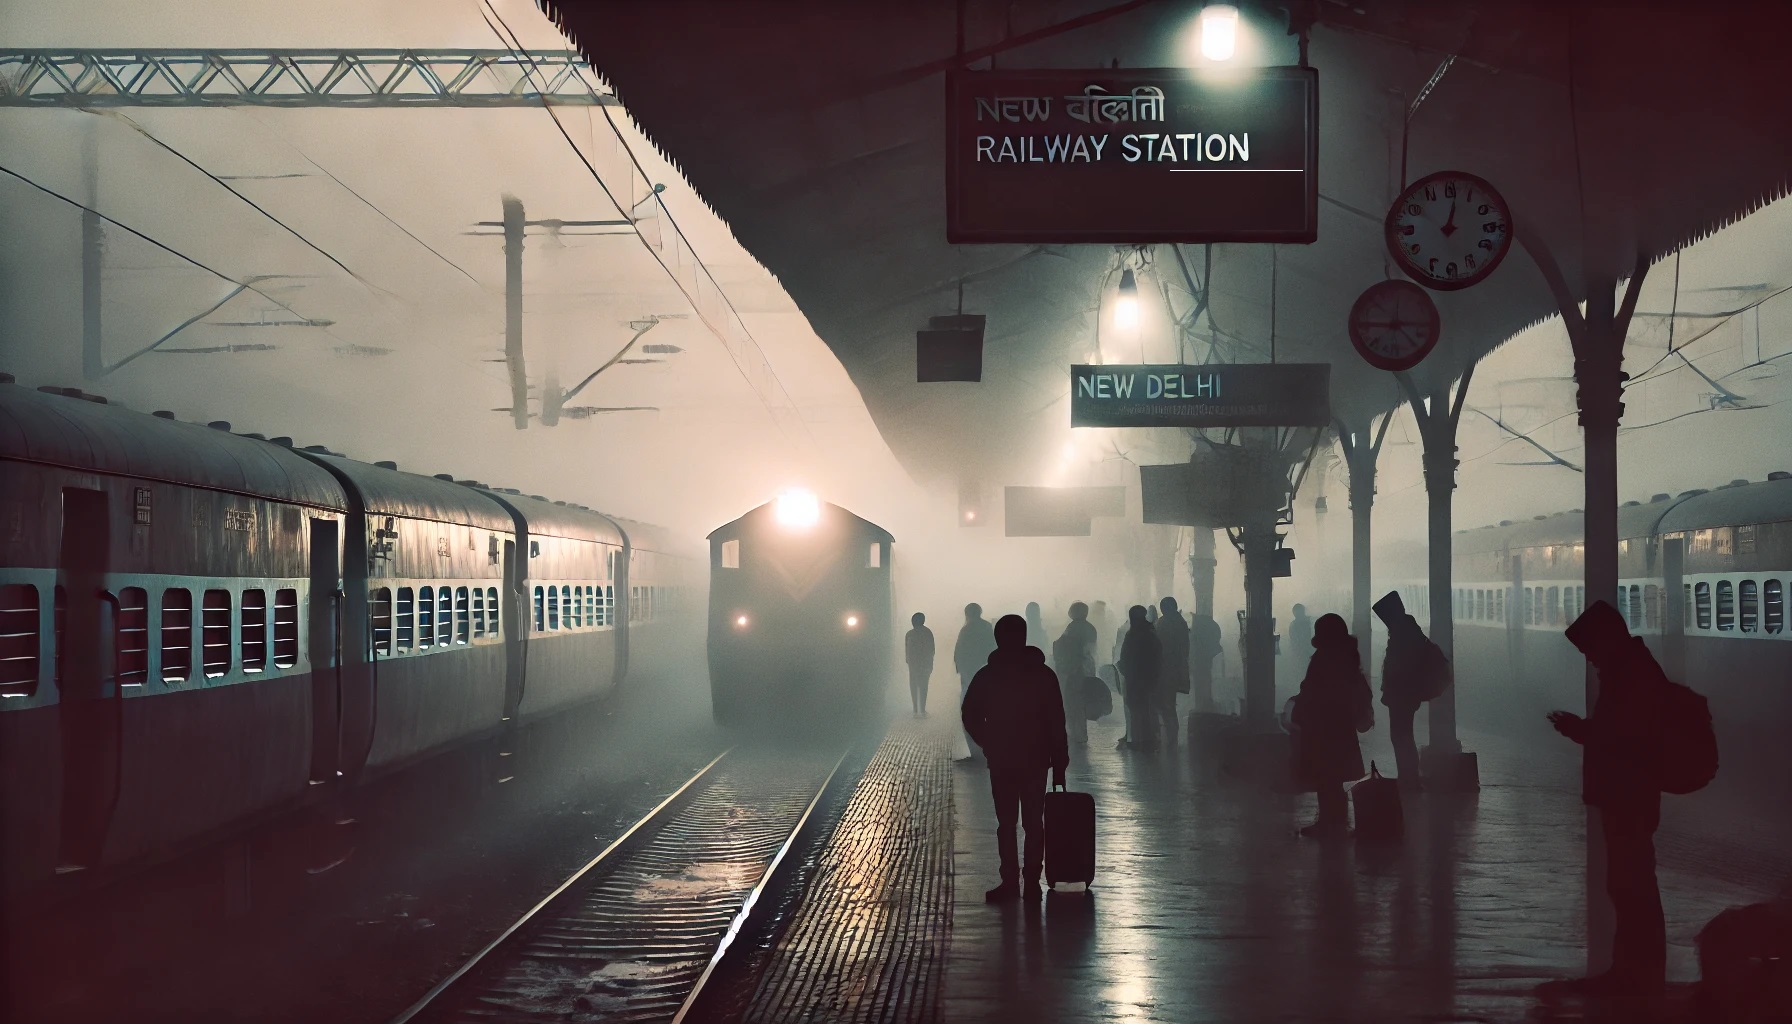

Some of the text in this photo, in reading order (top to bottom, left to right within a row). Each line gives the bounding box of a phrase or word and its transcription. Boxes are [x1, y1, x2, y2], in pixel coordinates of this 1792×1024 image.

[976, 132, 1250, 163] RAILWAY STATION
[1078, 373, 1221, 399] NEW DELHI
